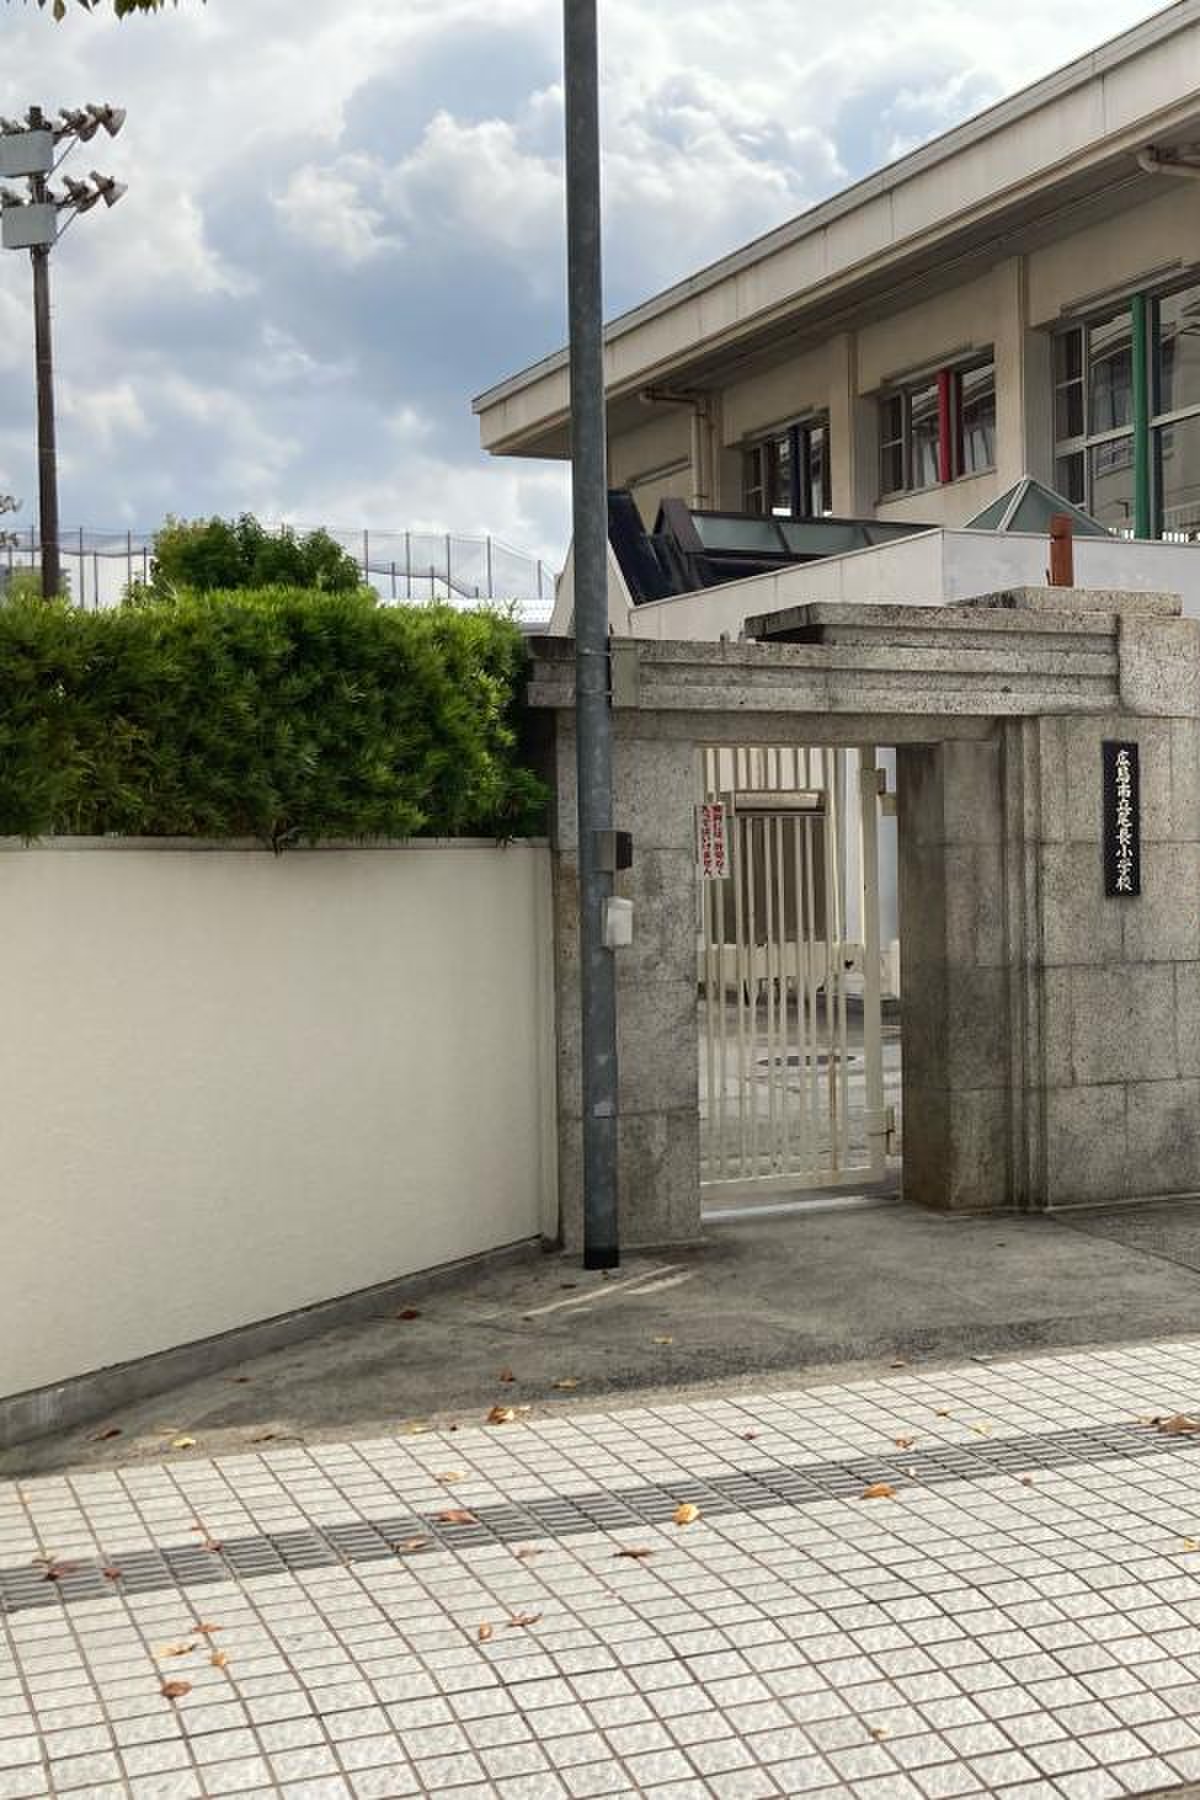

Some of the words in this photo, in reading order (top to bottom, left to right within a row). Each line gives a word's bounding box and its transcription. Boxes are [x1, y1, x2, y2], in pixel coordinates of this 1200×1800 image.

[1115, 749, 1133, 891] 広島市立尾長小学校
